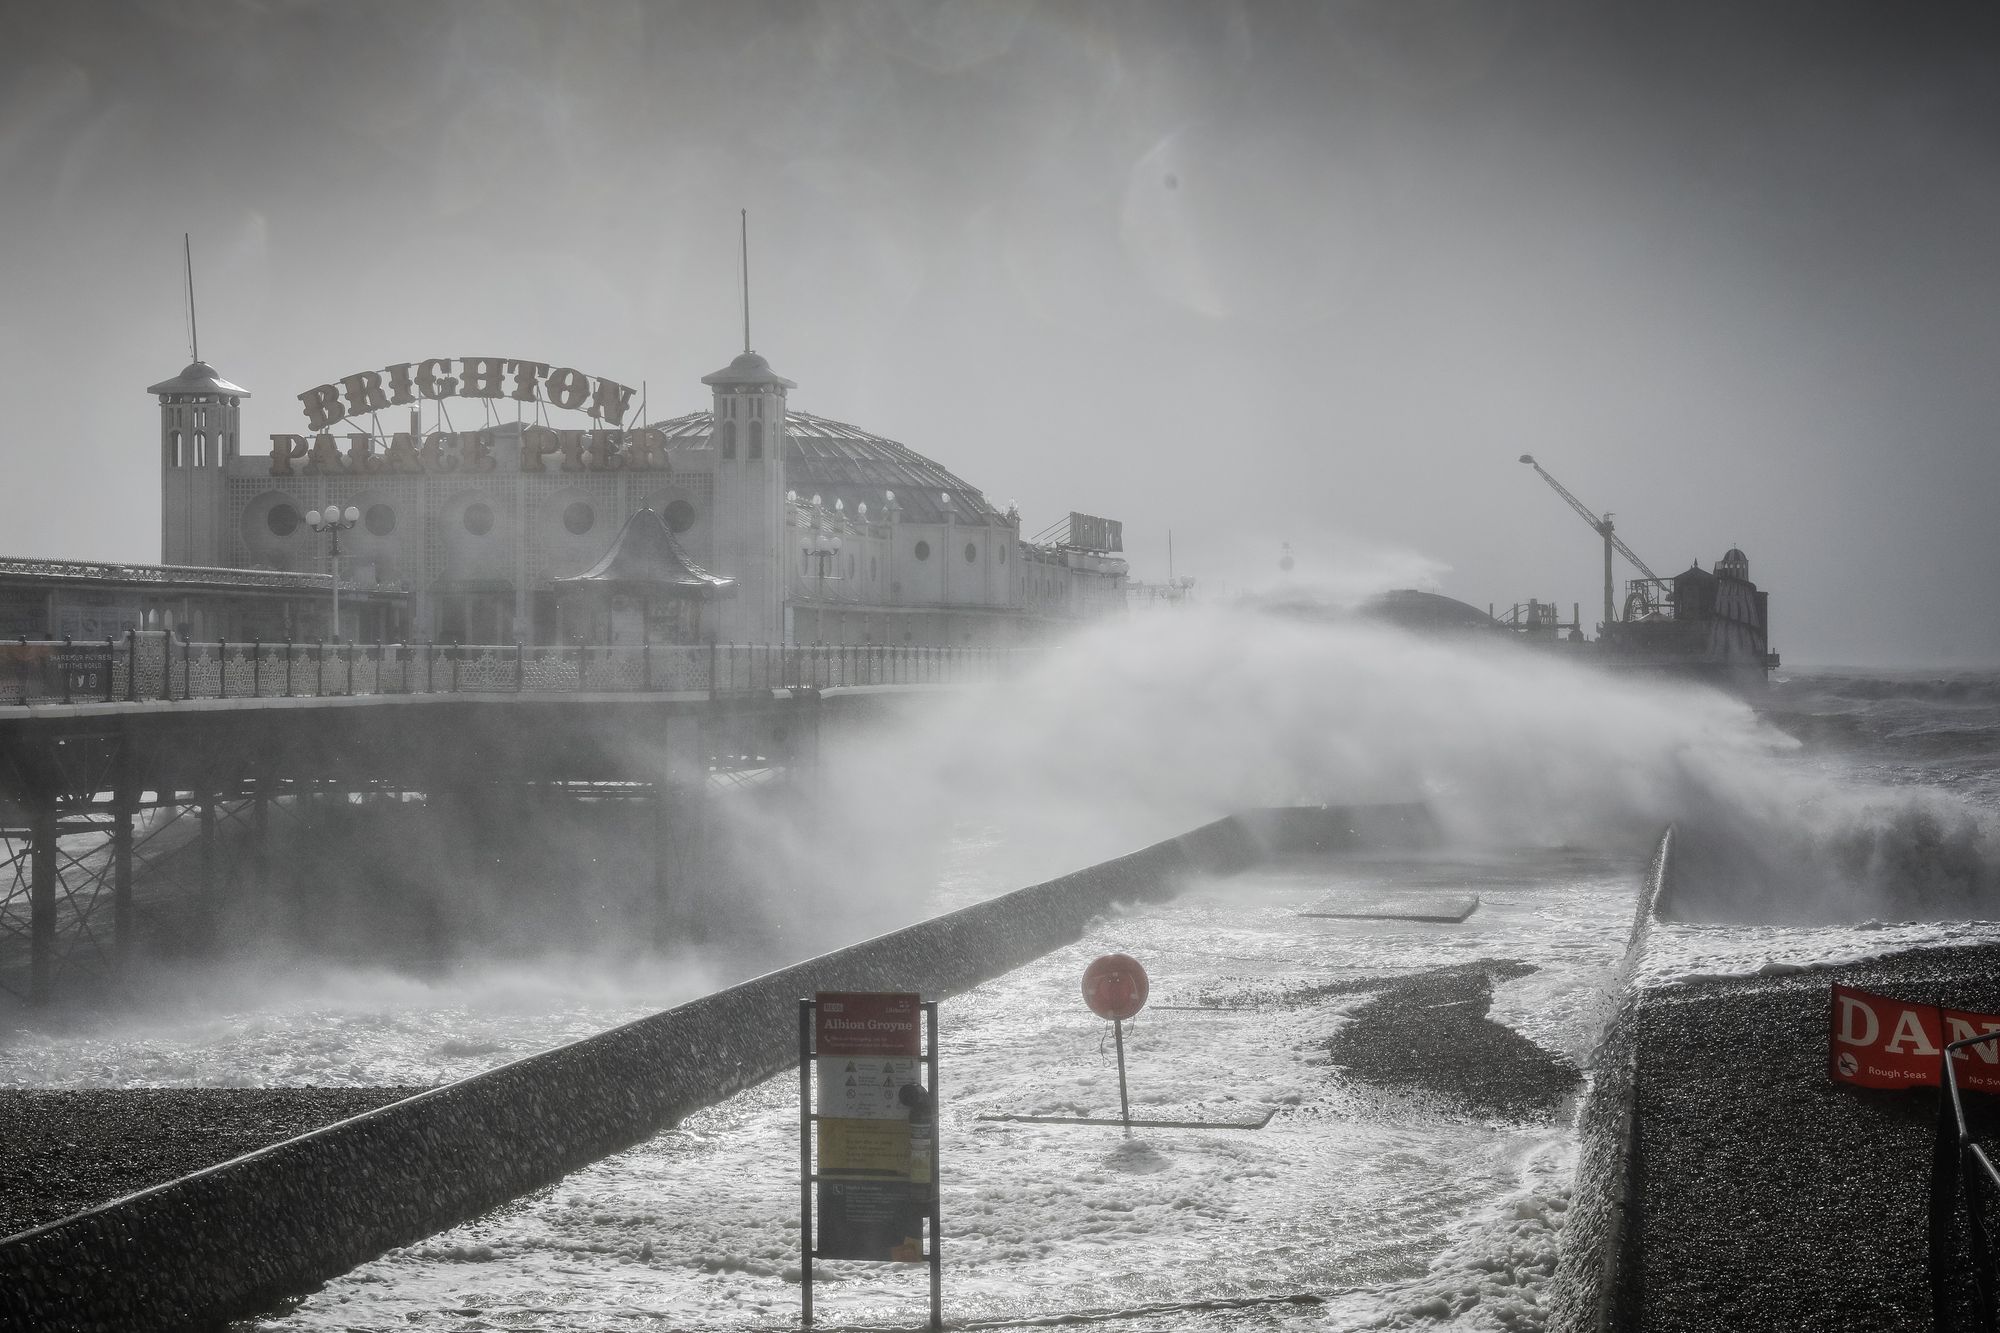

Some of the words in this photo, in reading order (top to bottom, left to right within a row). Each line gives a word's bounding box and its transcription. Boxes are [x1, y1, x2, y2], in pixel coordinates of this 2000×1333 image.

[297, 357, 637, 431] BRIGHTON
[269, 430, 497, 476] PALACE
[520, 427, 672, 473] PIER
[824, 1018, 865, 1030] Albion
[867, 1019, 913, 1032] Groyne
[1837, 995, 2000, 1064] DAN
[1868, 1066, 1900, 1079] Rough
[1903, 1071, 1927, 1079] Seas
[1969, 1076, 1984, 1085] No
